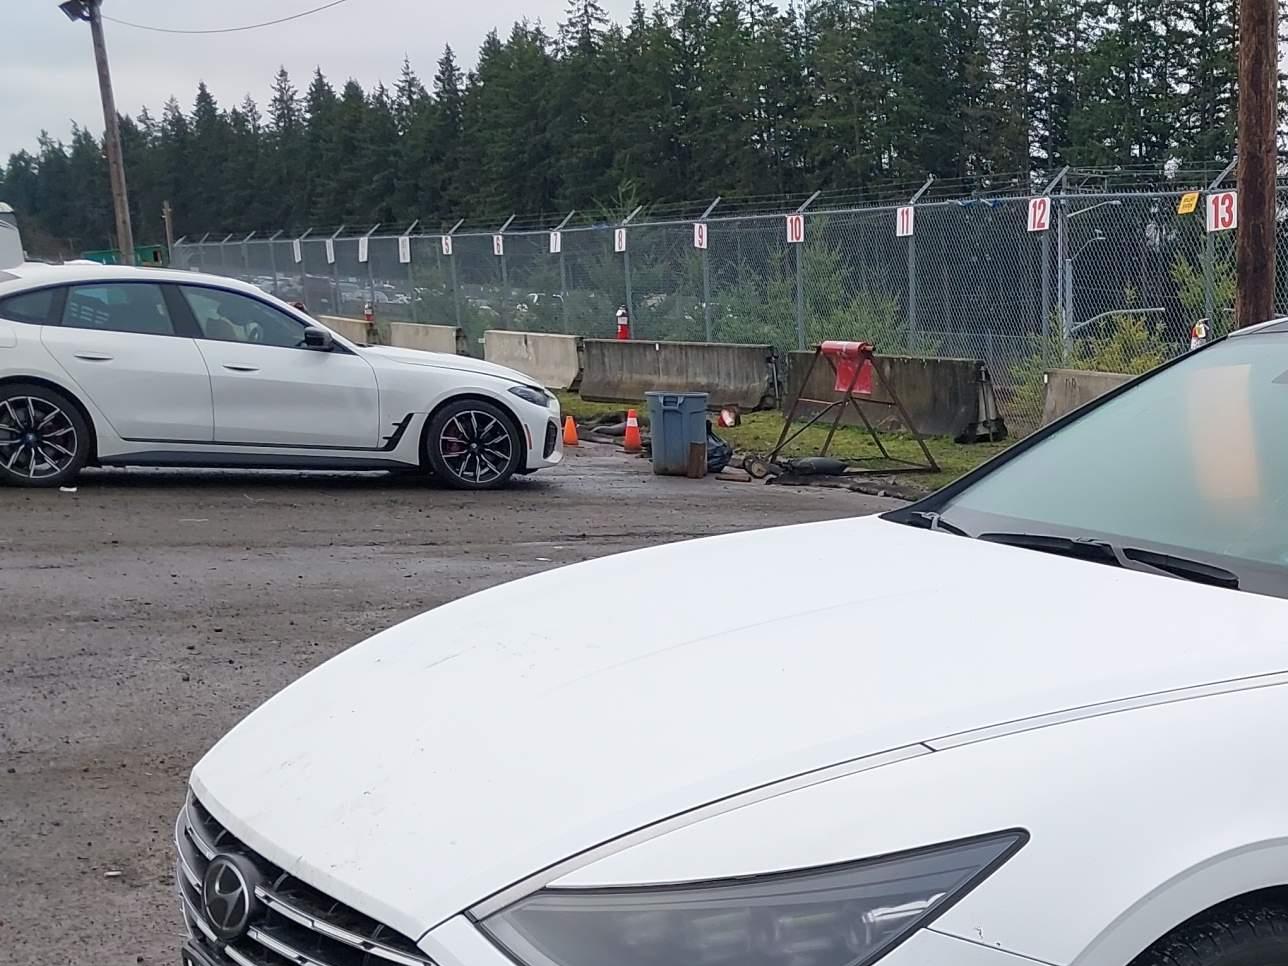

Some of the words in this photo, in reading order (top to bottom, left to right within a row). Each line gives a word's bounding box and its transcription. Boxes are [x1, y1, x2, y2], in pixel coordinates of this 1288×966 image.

[900, 208, 910, 235] 11
[1032, 199, 1047, 229] 12
[1211, 193, 1234, 229] 13
[617, 229, 623, 250] 8
[698, 225, 704, 247] 9
[789, 216, 801, 241] 10
